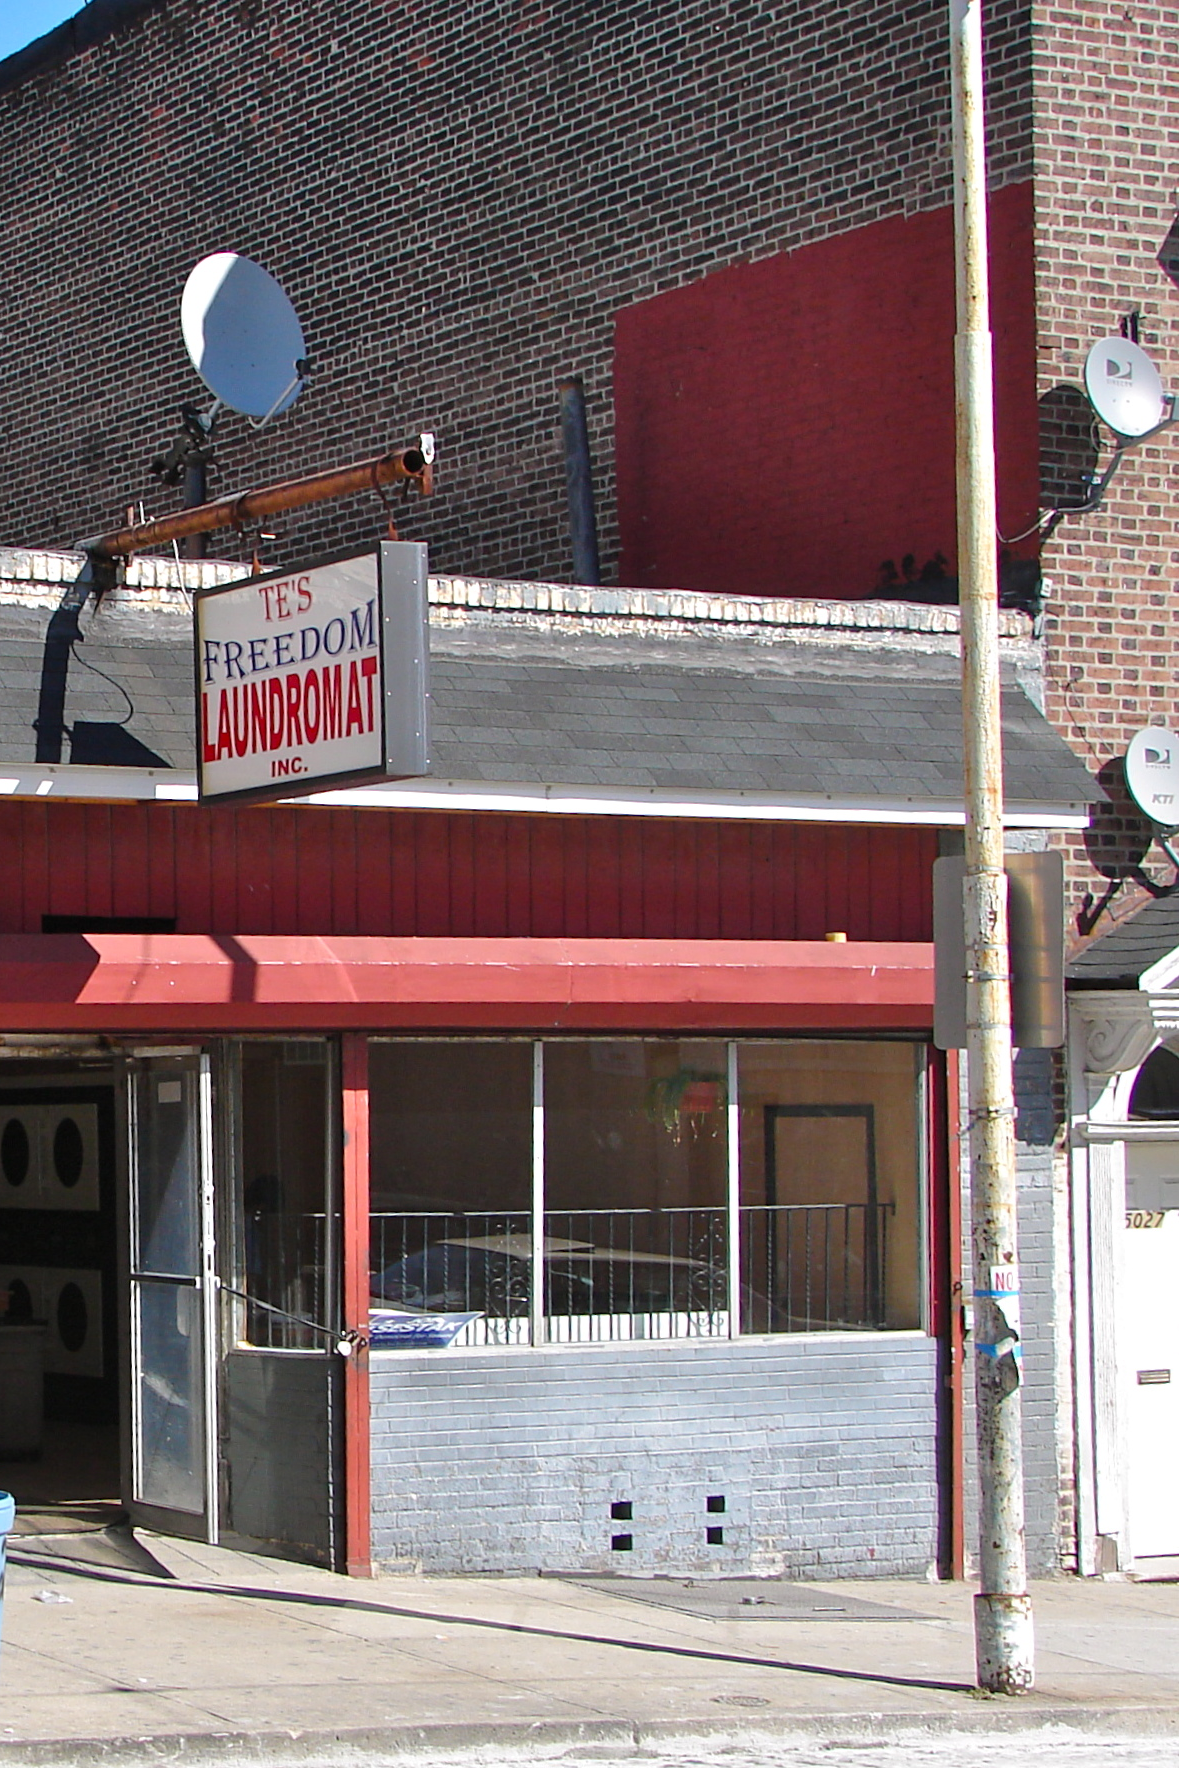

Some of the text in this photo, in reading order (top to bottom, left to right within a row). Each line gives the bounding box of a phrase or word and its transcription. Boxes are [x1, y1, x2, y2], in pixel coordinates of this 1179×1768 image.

[258, 576, 313, 622] TE'S
[203, 599, 378, 684] FREEDOM
[202, 656, 377, 763] LAUNDROMAT
[271, 757, 308, 778] INC.
[1125, 1212, 1165, 1229] 5027
[995, 1271, 1014, 1290] NO
